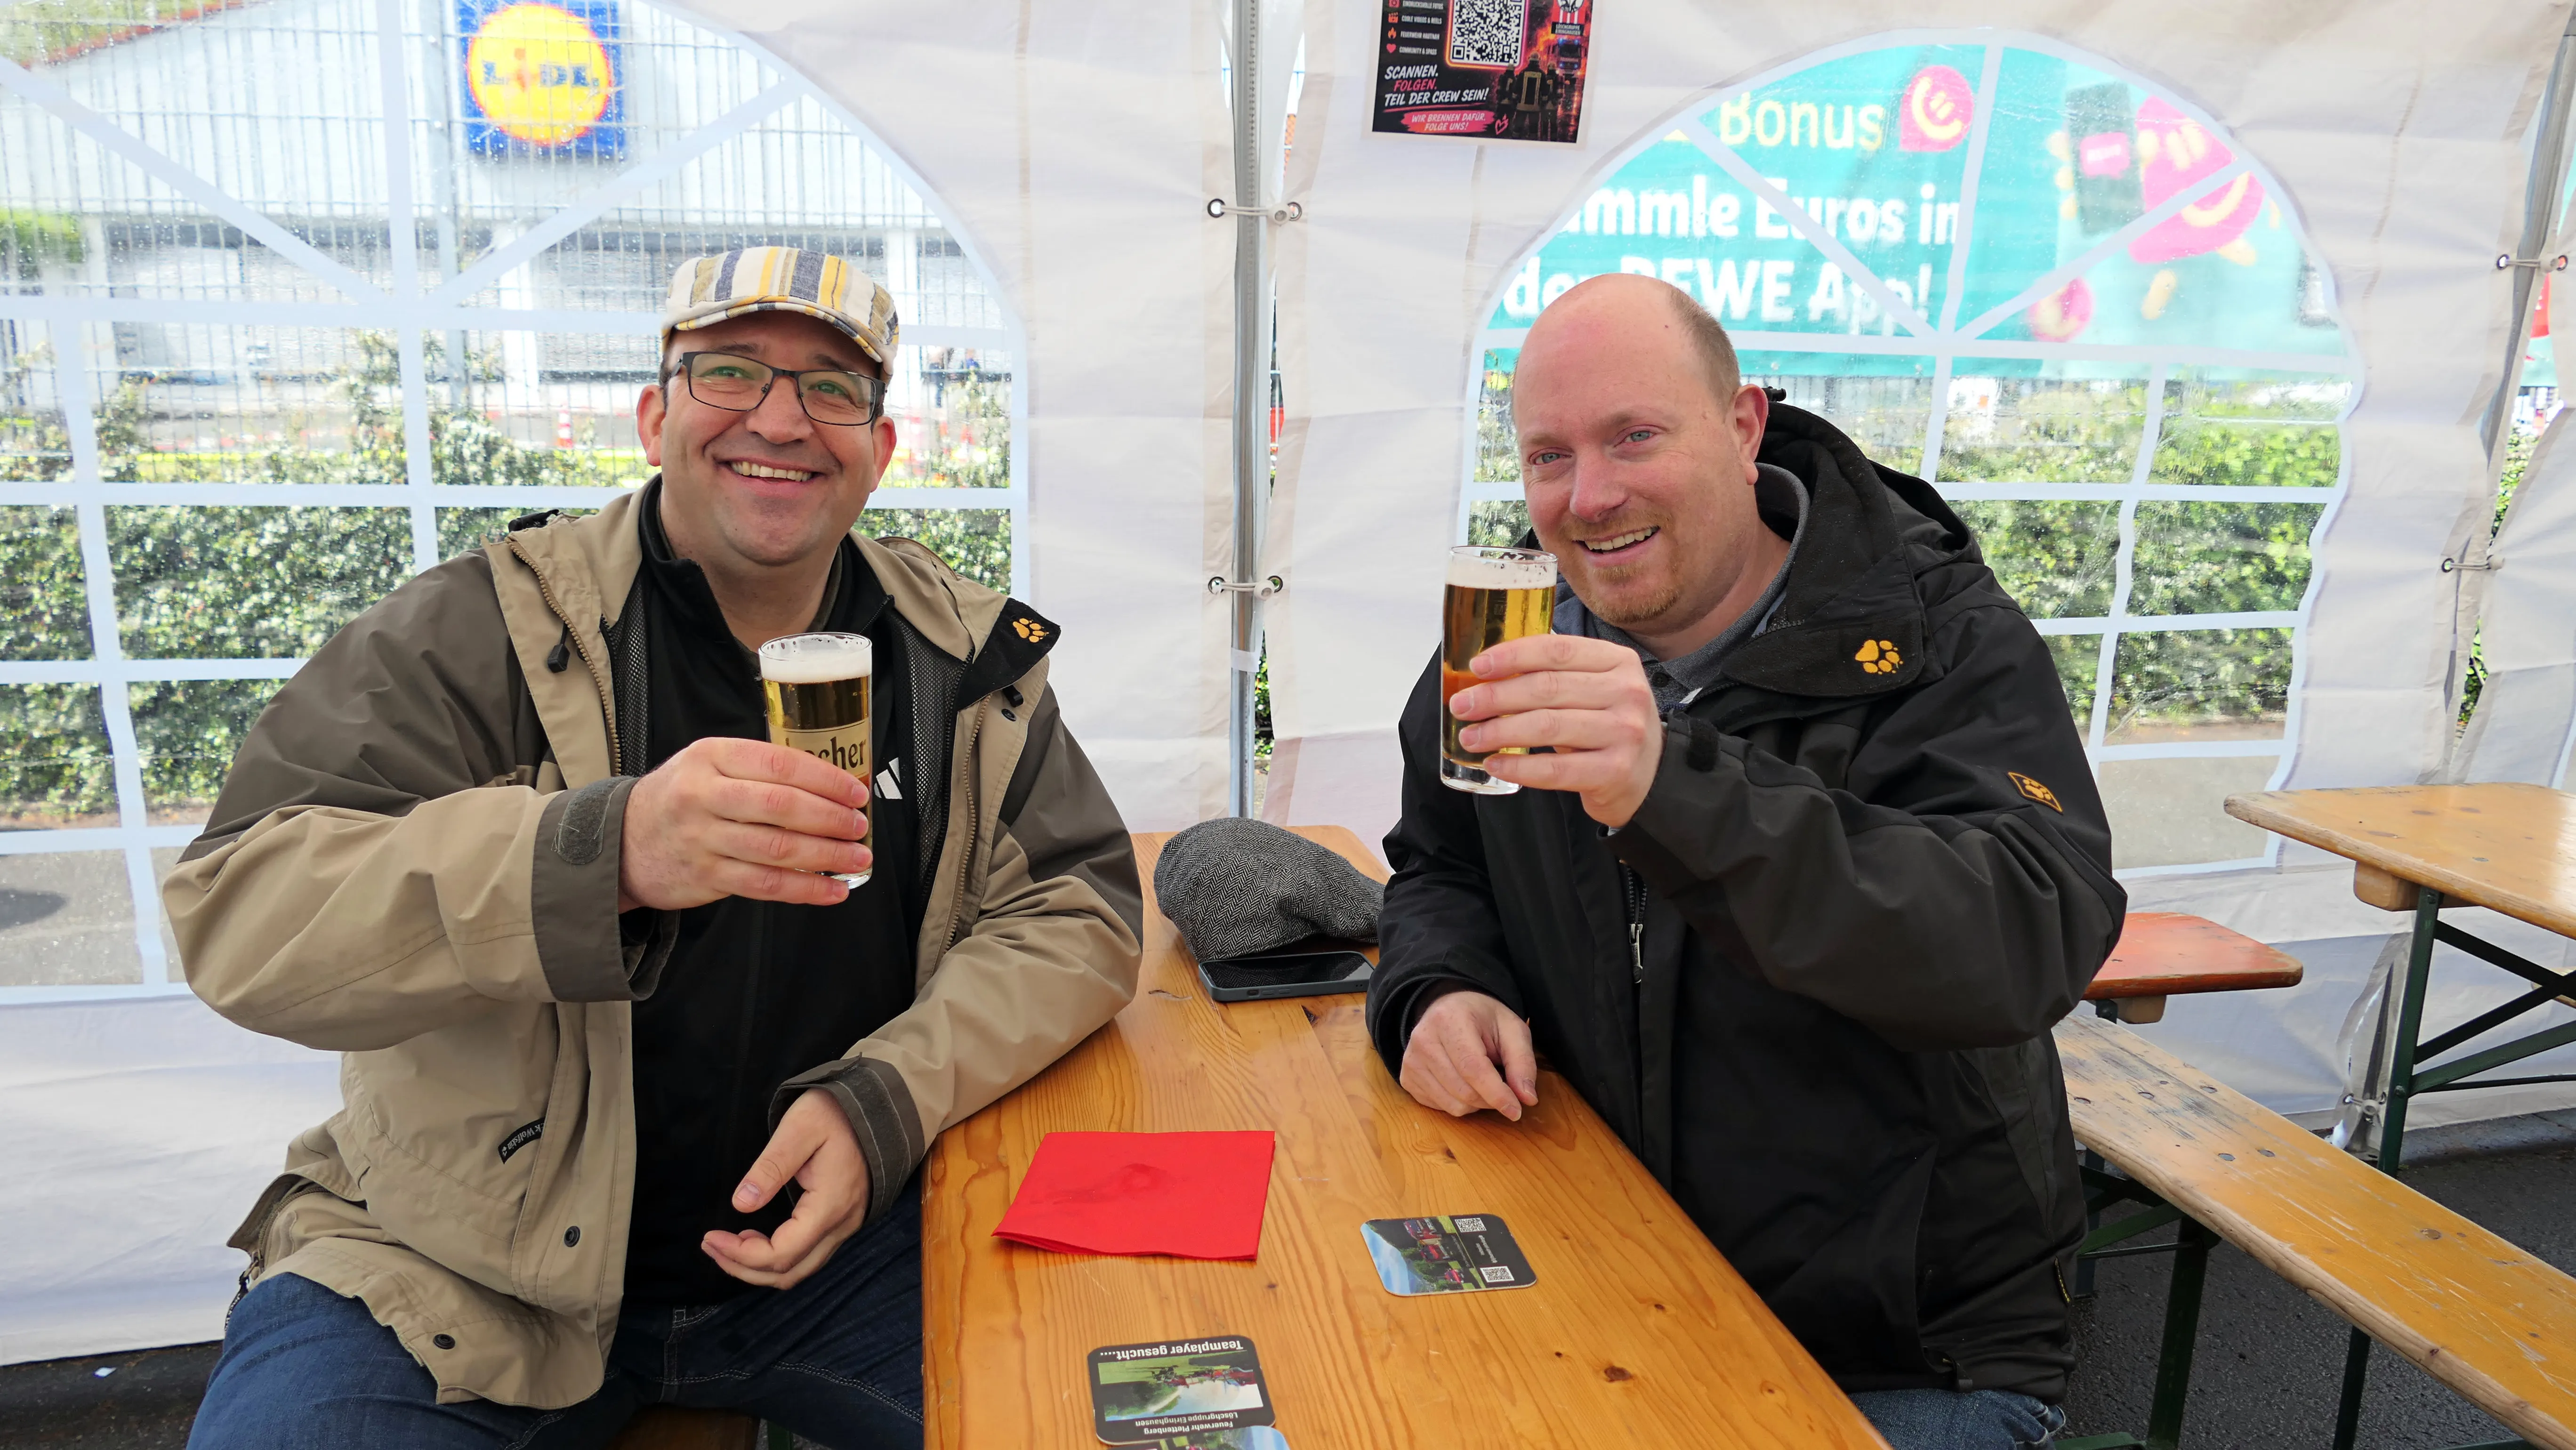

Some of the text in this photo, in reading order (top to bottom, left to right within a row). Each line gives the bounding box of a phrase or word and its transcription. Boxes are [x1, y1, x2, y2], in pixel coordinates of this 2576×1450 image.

[1400, 31, 1422, 39] FEUERWEHR
[1399, 46, 1422, 54] COMMUNITY
[1384, 65, 1438, 80] SCANNEN.
[1393, 79, 1437, 92] FOLGEN.
[1385, 87, 1489, 107] TEIL DER CREW SEIN!
[1411, 112, 1486, 123] WIR BRENNEN DAFÜR.
[1720, 92, 1884, 150] Bonus
[1424, 122, 1469, 131] FOLGE UNS!
[507, 1128, 535, 1150] Wolfskin
[1170, 1340, 1244, 1354] Teamplayer
[1135, 1412, 1238, 1426] Löschgruppe Eiringhausen
[1144, 1421, 1233, 1435] Feuerwehr Plettenberg
